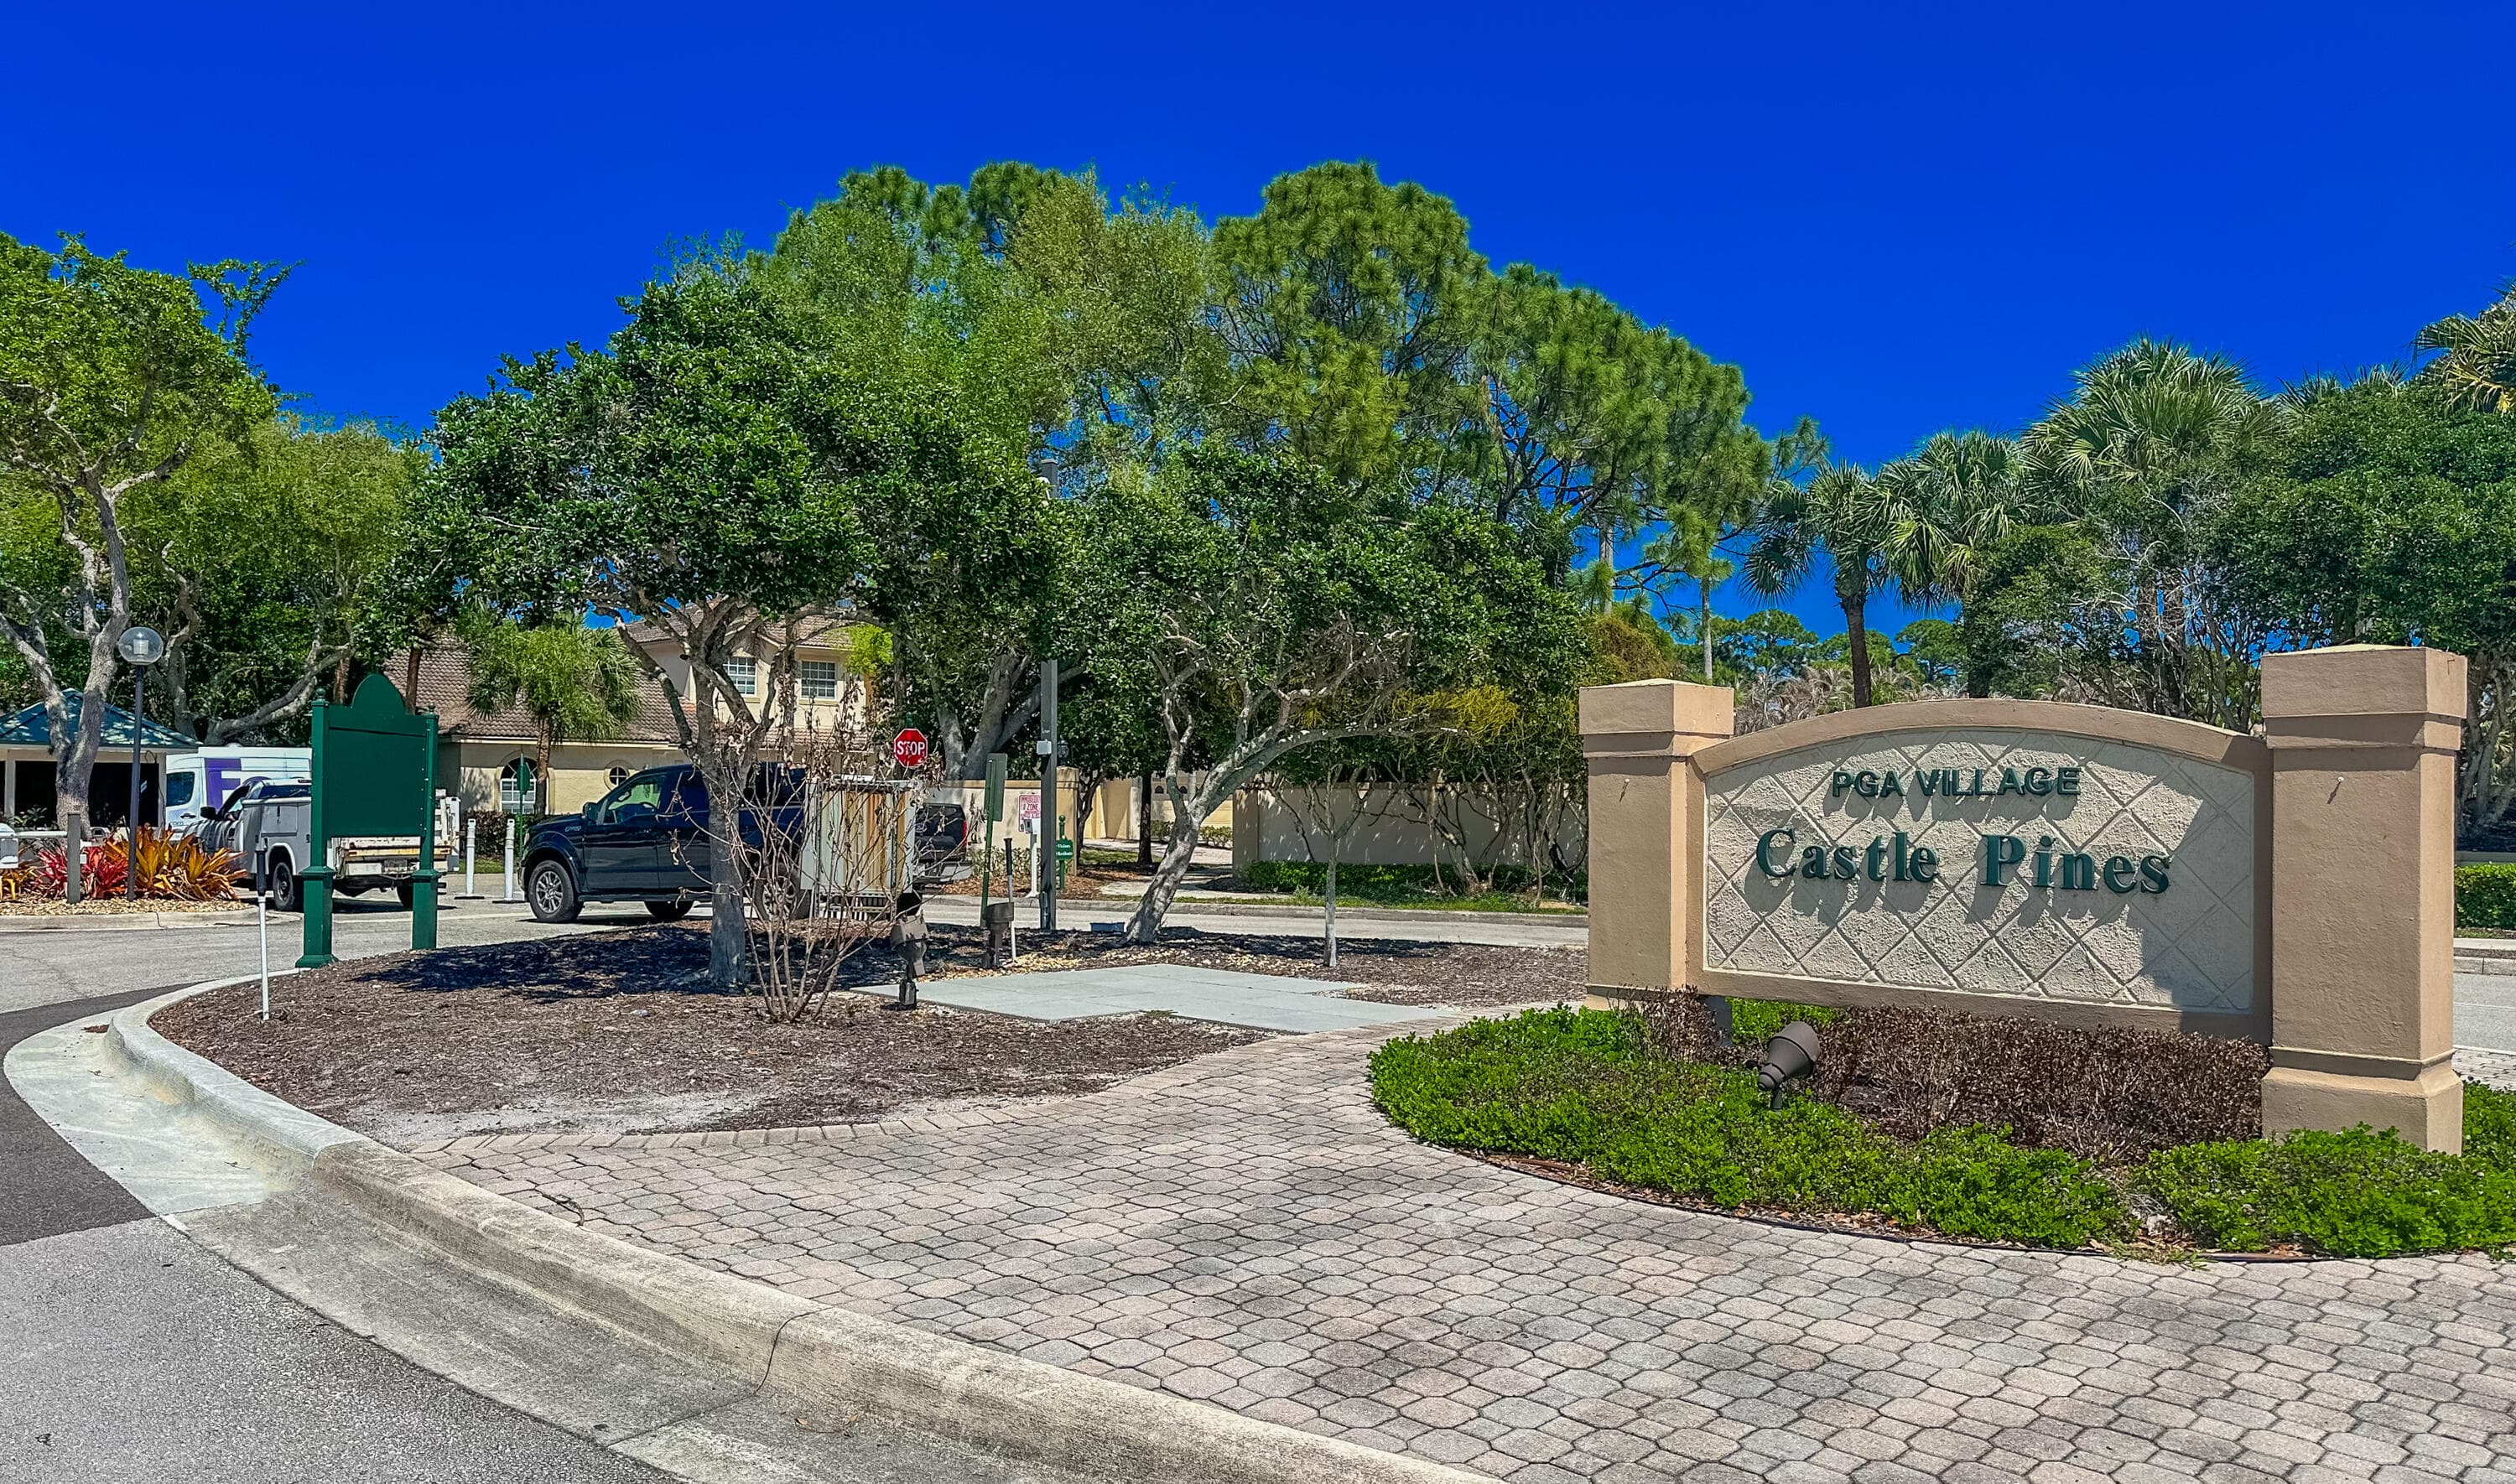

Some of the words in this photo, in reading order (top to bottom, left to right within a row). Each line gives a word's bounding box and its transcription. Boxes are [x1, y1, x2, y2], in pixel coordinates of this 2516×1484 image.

[897, 740, 926, 755] STOP
[1832, 769, 1907, 797] PGA
[1916, 766, 2082, 796] VILLAGE
[1755, 827, 1940, 883] Castle
[1979, 833, 2176, 894] Pines
